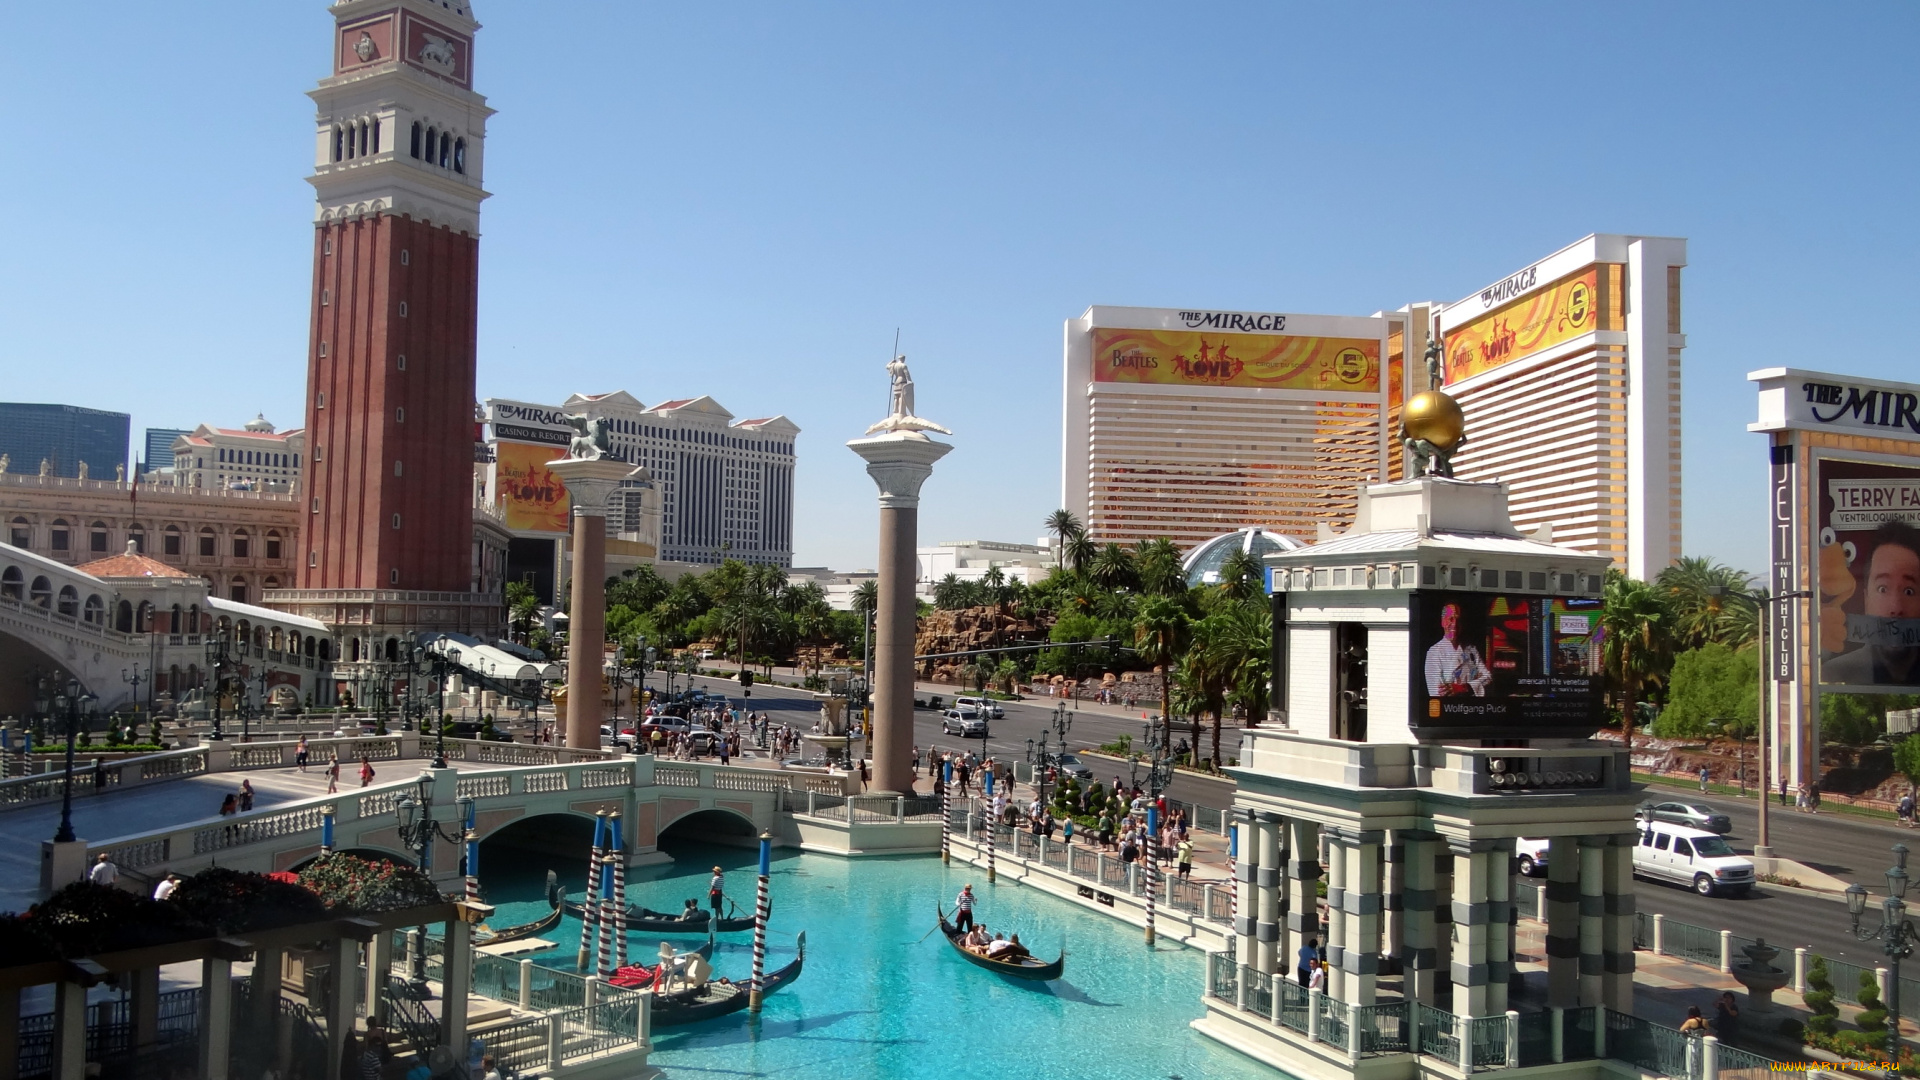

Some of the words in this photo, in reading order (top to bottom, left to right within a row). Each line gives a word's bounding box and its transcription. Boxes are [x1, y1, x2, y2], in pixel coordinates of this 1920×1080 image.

[1484, 267, 1537, 308] MIRAGE
[1179, 312, 1201, 321] THE
[1186, 313, 1286, 332] MIRAGE
[1486, 336, 1509, 361] LOVE
[1113, 350, 1159, 369] BEATLES
[1184, 360, 1231, 377] LOVE
[1803, 383, 1842, 405] THE
[496, 404, 513, 413] THE
[1812, 388, 1920, 434] MIR
[498, 427, 529, 437] CASINO
[539, 432, 571, 443] RESORT
[514, 484, 554, 502] LOVE
[1838, 488, 1895, 507] TERRY
[1901, 487, 1920, 506] FA
[1839, 513, 1905, 523] VENTRILOQUISM
[1907, 513, 1915, 521] IN
[1443, 704, 1484, 715] Wolfgang
[1486, 704, 1507, 713] Puck
